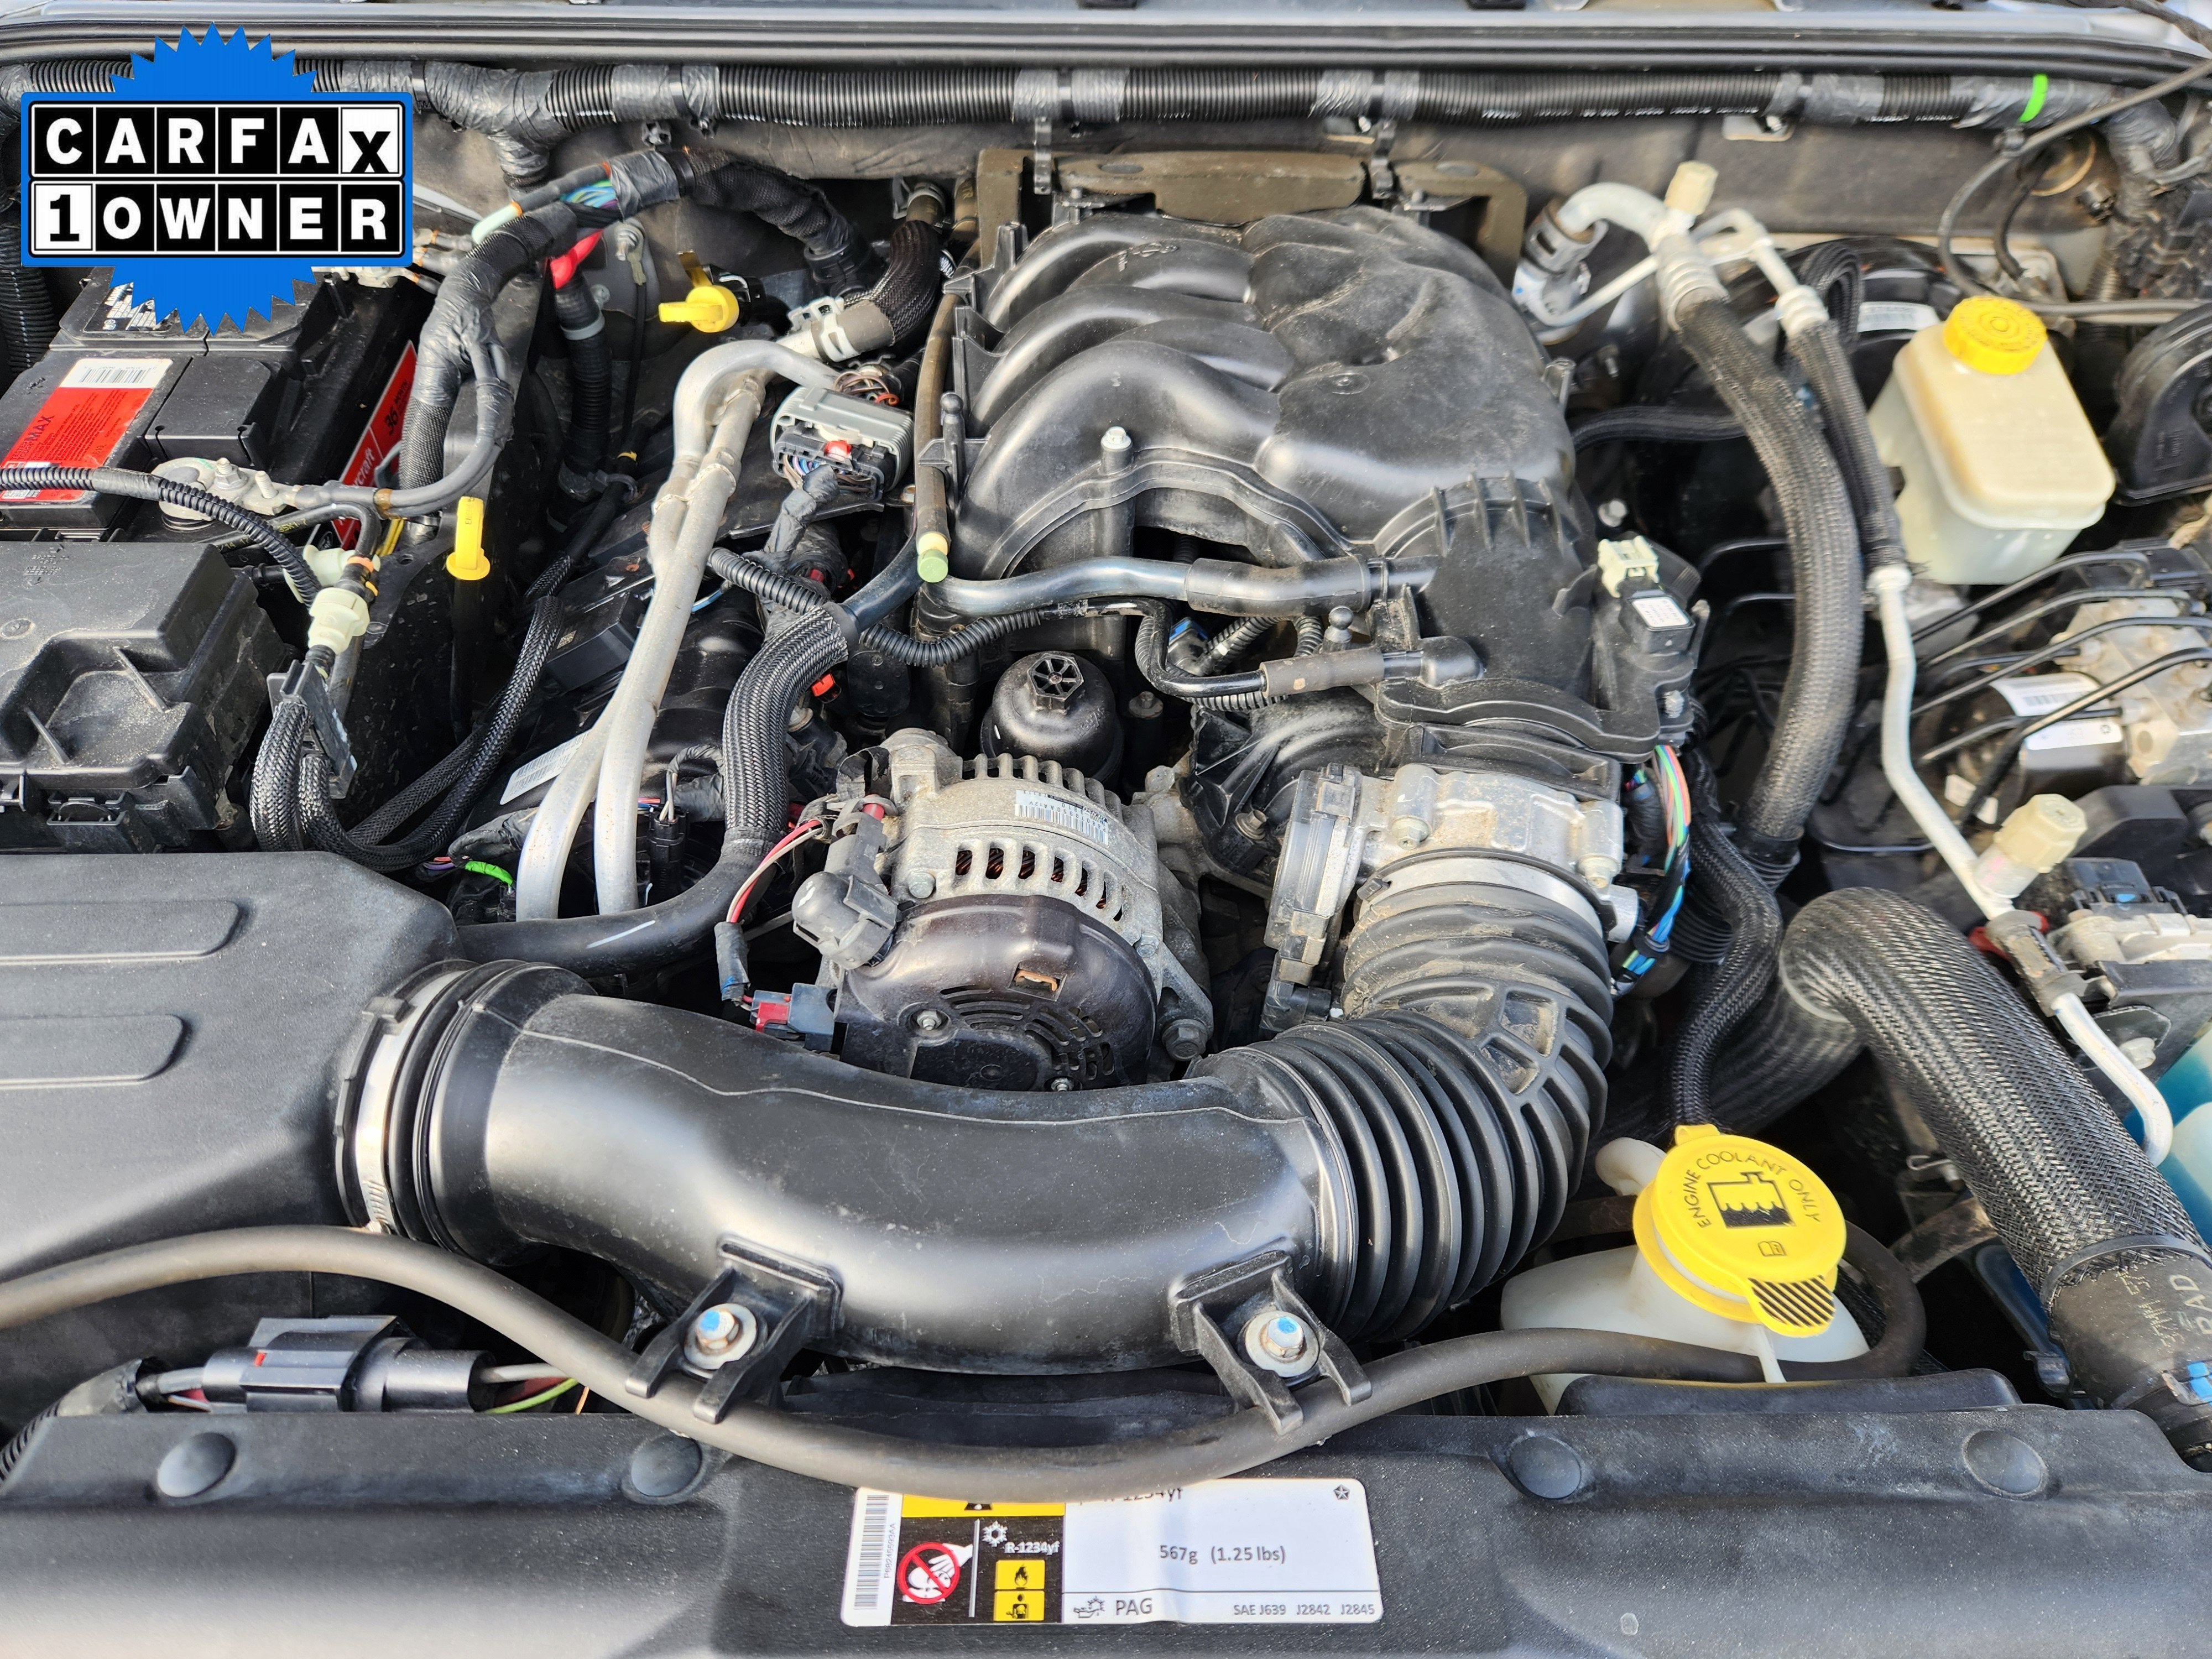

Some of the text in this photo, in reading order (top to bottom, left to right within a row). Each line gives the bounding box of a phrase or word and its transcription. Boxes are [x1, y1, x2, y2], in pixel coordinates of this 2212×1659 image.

[24, 415, 55, 441] MAX
[1683, 1151, 1822, 1228] ENGINE COOLANT ONLY
[1005, 1540, 1060, 1556] R-1234yf
[1159, 1544, 1286, 1564] 567g (1.25 lbs)
[1115, 1598, 1375, 1616] PAG SAE J639 J2842 J2845
